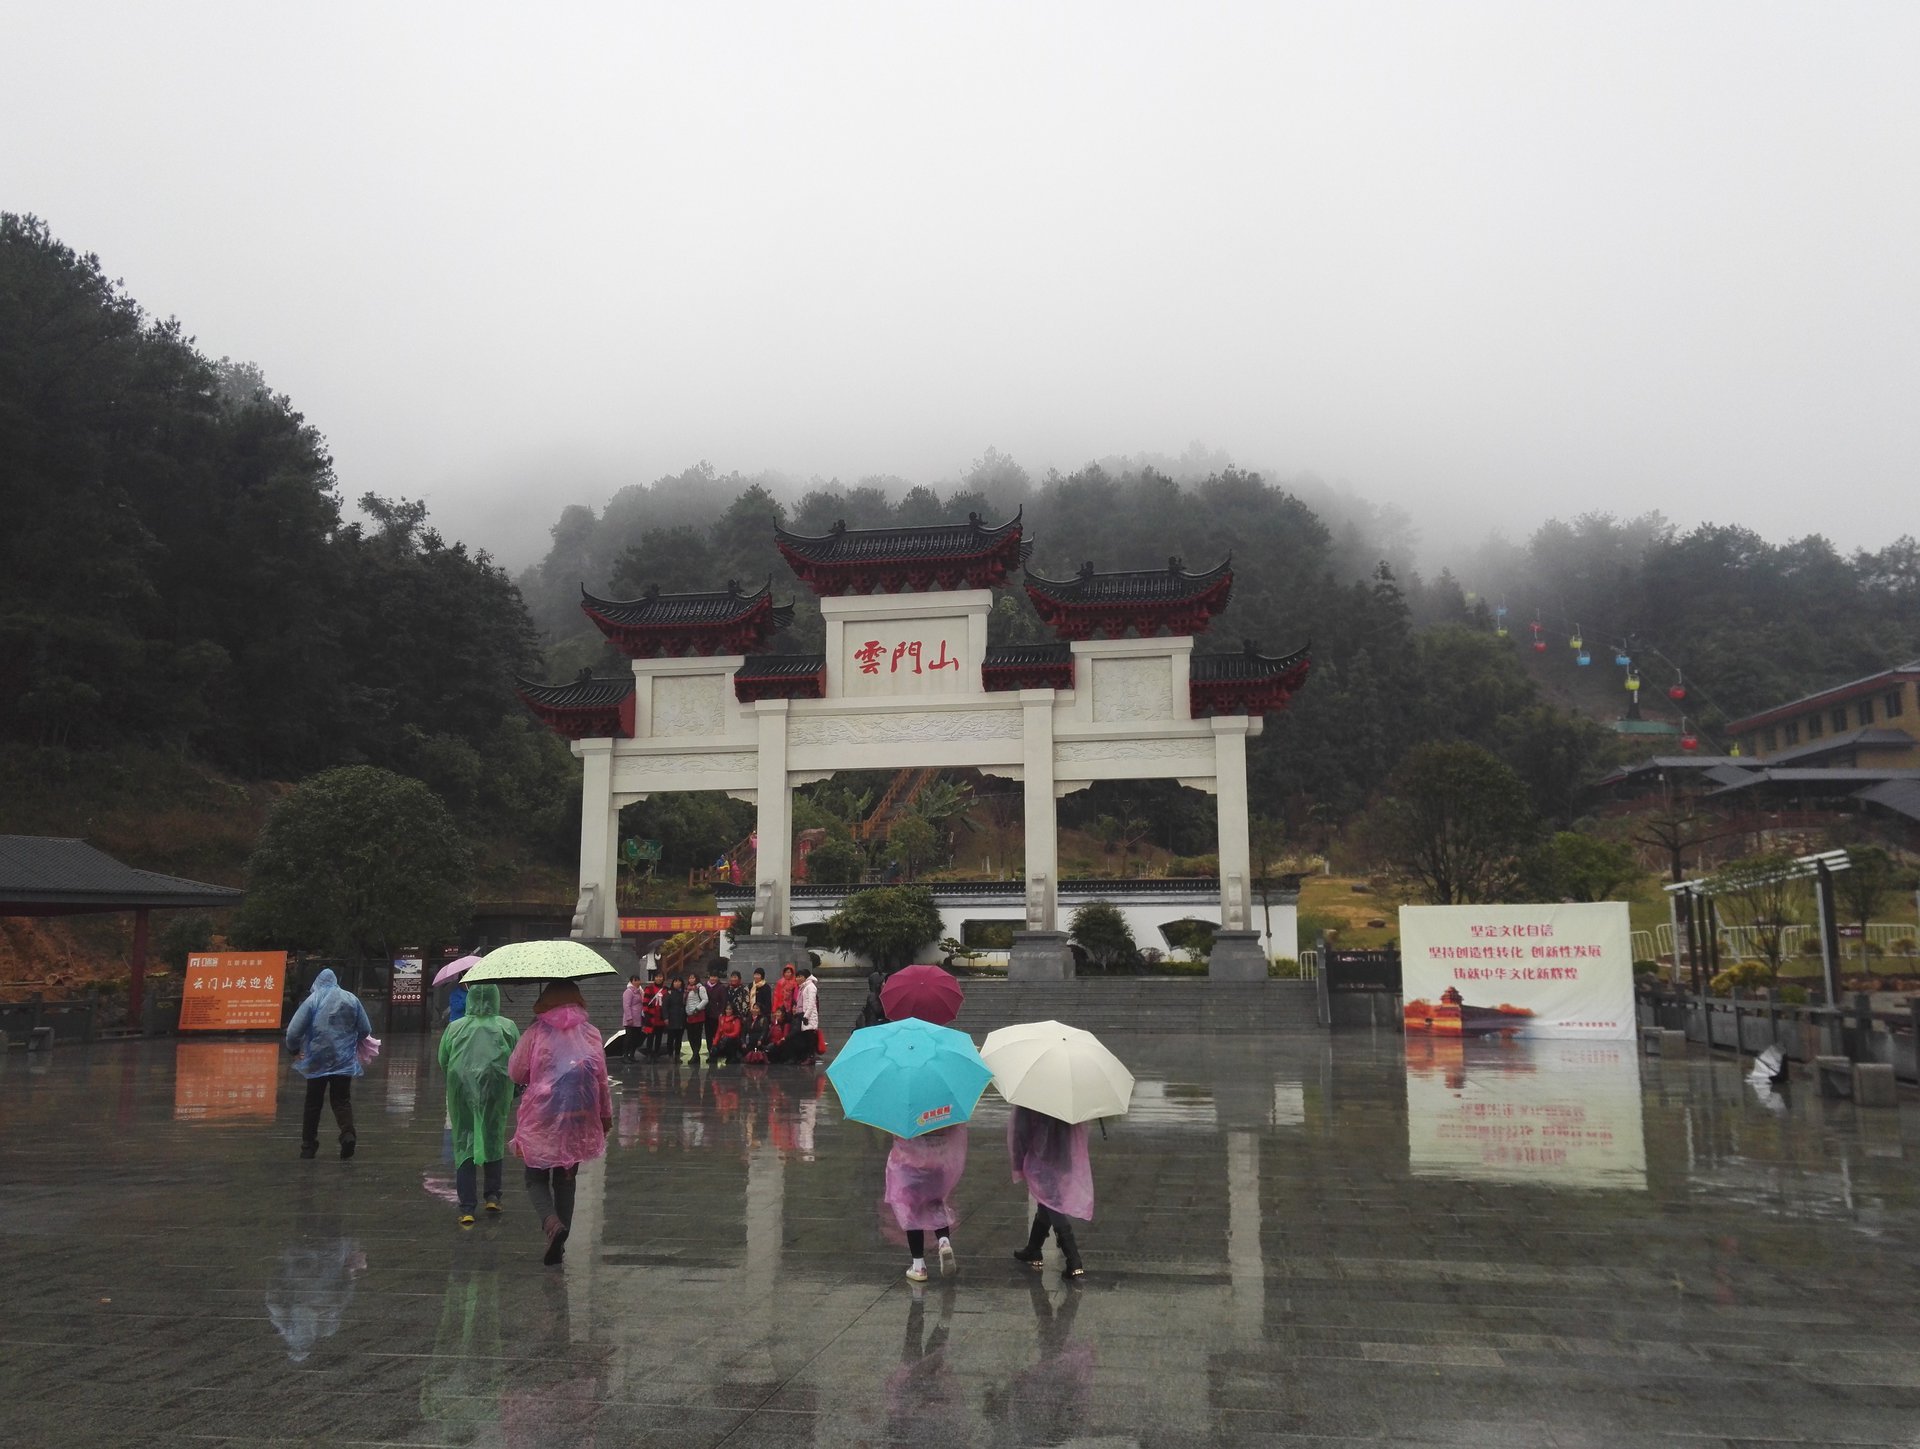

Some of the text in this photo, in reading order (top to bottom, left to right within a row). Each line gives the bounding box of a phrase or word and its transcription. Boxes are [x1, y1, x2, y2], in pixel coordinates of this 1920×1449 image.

[854, 640, 959, 674] 雲門山
[1471, 924, 1554, 938] 坚定文化自信
[1429, 945, 1602, 959] 坚持创造性转化 创新性发展
[1454, 967, 1578, 980] 铸就中华文化新辉煌
[193, 975, 275, 990] 云门山欢迎您
